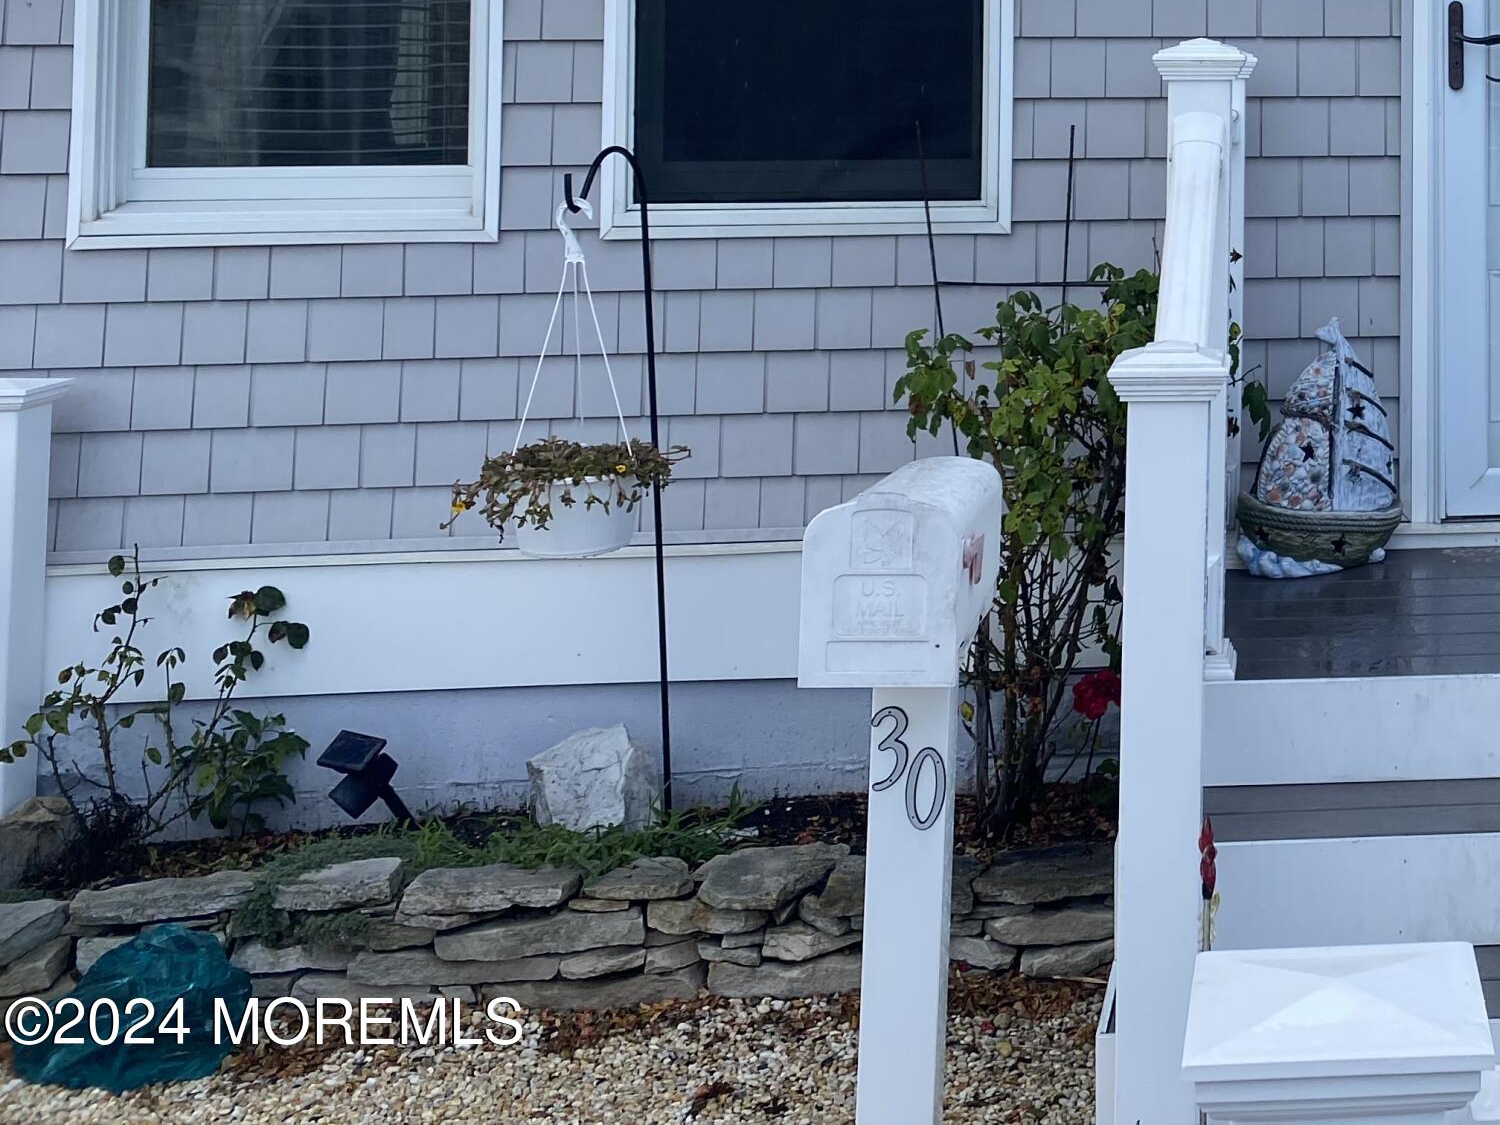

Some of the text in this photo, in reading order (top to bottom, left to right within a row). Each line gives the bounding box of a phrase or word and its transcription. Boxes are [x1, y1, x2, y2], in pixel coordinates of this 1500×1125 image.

[861, 578, 901, 597] U.S.
[856, 600, 904, 618] MAIL
[870, 705, 947, 831] 30
